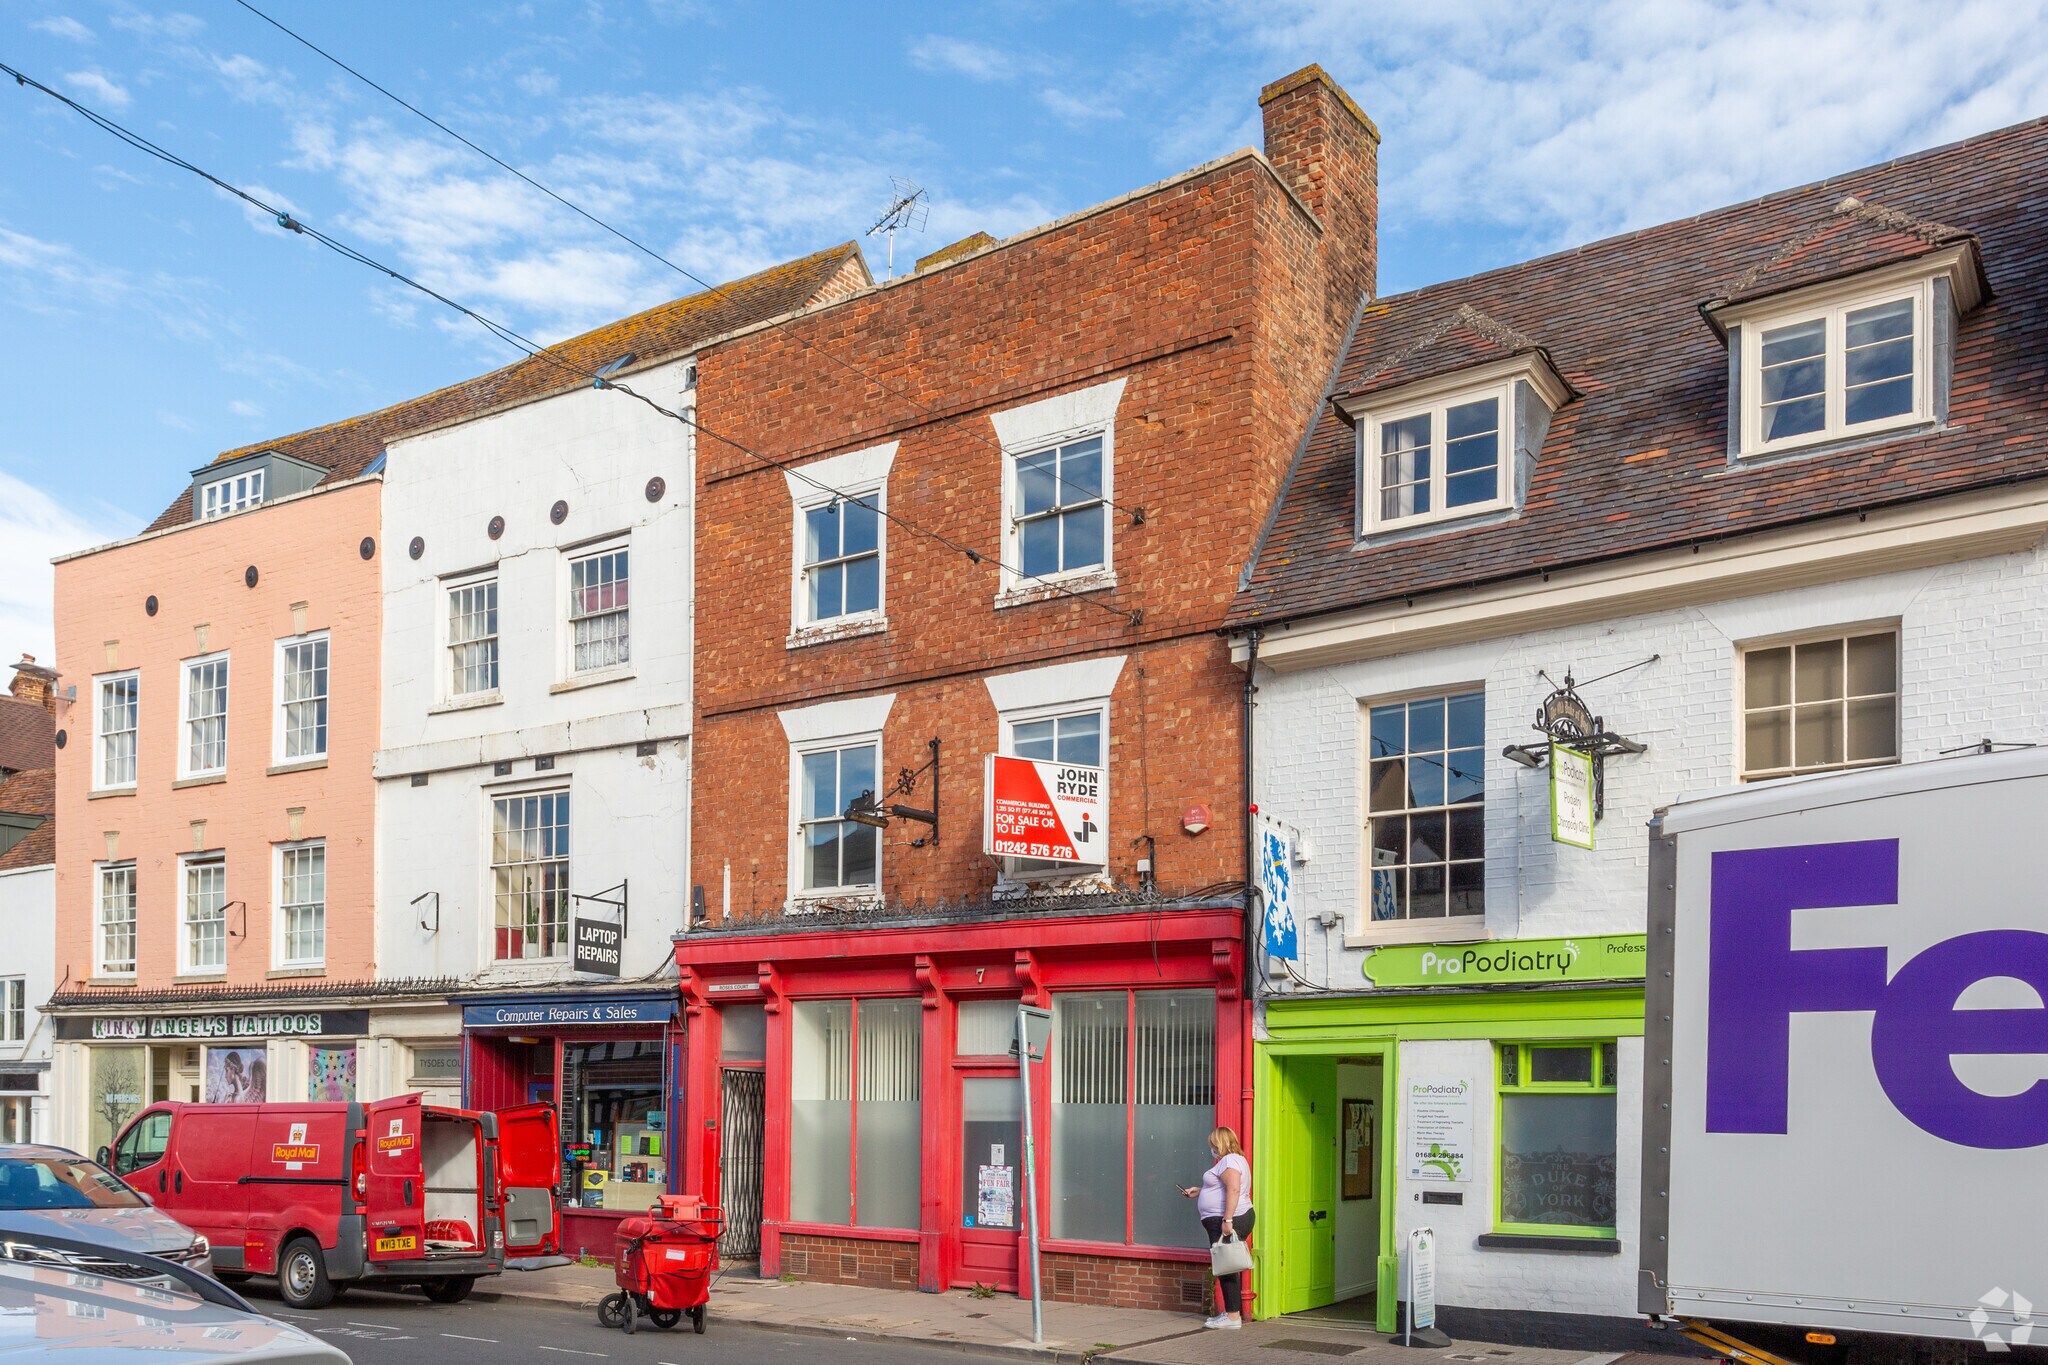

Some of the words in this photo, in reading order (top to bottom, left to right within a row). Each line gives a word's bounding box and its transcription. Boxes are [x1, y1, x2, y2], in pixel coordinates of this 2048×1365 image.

[1057, 769, 1098, 784] JOHN
[1057, 782, 1098, 797] RYDE
[996, 799, 1027, 807] COMMERCIAL
[1057, 795, 1098, 804] COMMERCIAL
[1564, 792, 1582, 810] Podiatry
[996, 813, 1014, 824] FOR
[1018, 815, 1039, 826] SALE
[1042, 818, 1055, 828] OR
[996, 824, 1009, 833] TO
[1012, 825, 1025, 835] LET
[995, 840, 1027, 854] 01242
[1030, 843, 1050, 856] 576
[1053, 846, 1072, 858] 276
[580, 926, 618, 945] LAPTOP
[577, 945, 618, 964] REPAIRS
[1422, 950, 1571, 975] ProPodiatry
[976, 968, 985, 984] 7
[496, 1009, 544, 1023] Computer
[549, 1008, 588, 1021] Repairs
[593, 1008, 600, 1019] &
[606, 1006, 637, 1019] Sales
[94, 1018, 146, 1037] KINKY
[153, 1017, 226, 1035] ANGEL'S
[234, 1014, 320, 1033] TATTOOS
[420, 1059, 444, 1068] TYSOES
[1413, 1085, 1463, 1095] ProPodiatry
[380, 1138, 397, 1148] Royal
[397, 1136, 411, 1146] Mail
[276, 1147, 297, 1160] Royal
[298, 1147, 316, 1158] Mail
[1531, 1171, 1587, 1187] DUKE
[1414, 1193, 1419, 1201] 8
[1536, 1193, 1584, 1207] YORK
[397, 1238, 411, 1248] TXE
